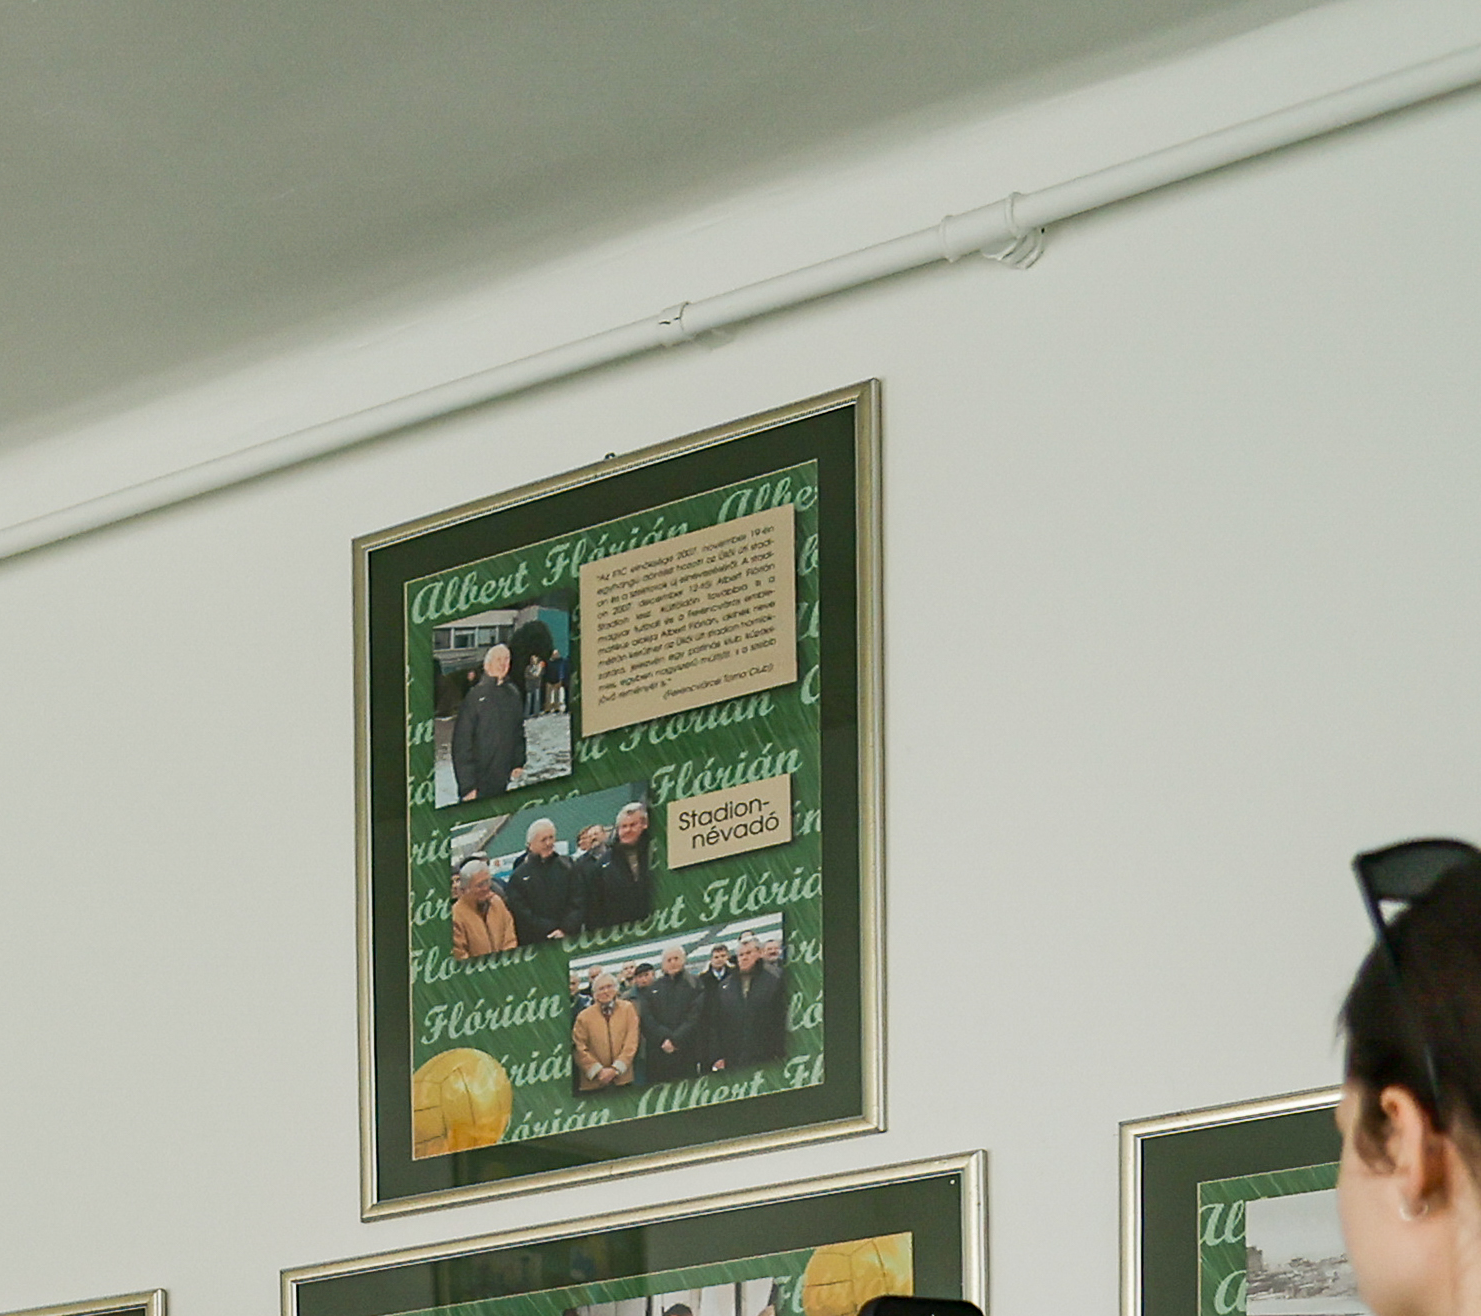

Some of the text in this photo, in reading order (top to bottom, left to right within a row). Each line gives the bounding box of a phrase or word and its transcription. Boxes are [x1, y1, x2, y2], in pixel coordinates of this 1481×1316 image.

[411, 558, 529, 624] Albert
[678, 797, 770, 832] Stadion-
[692, 816, 780, 849] névadó
[420, 986, 565, 1046] Flórián
